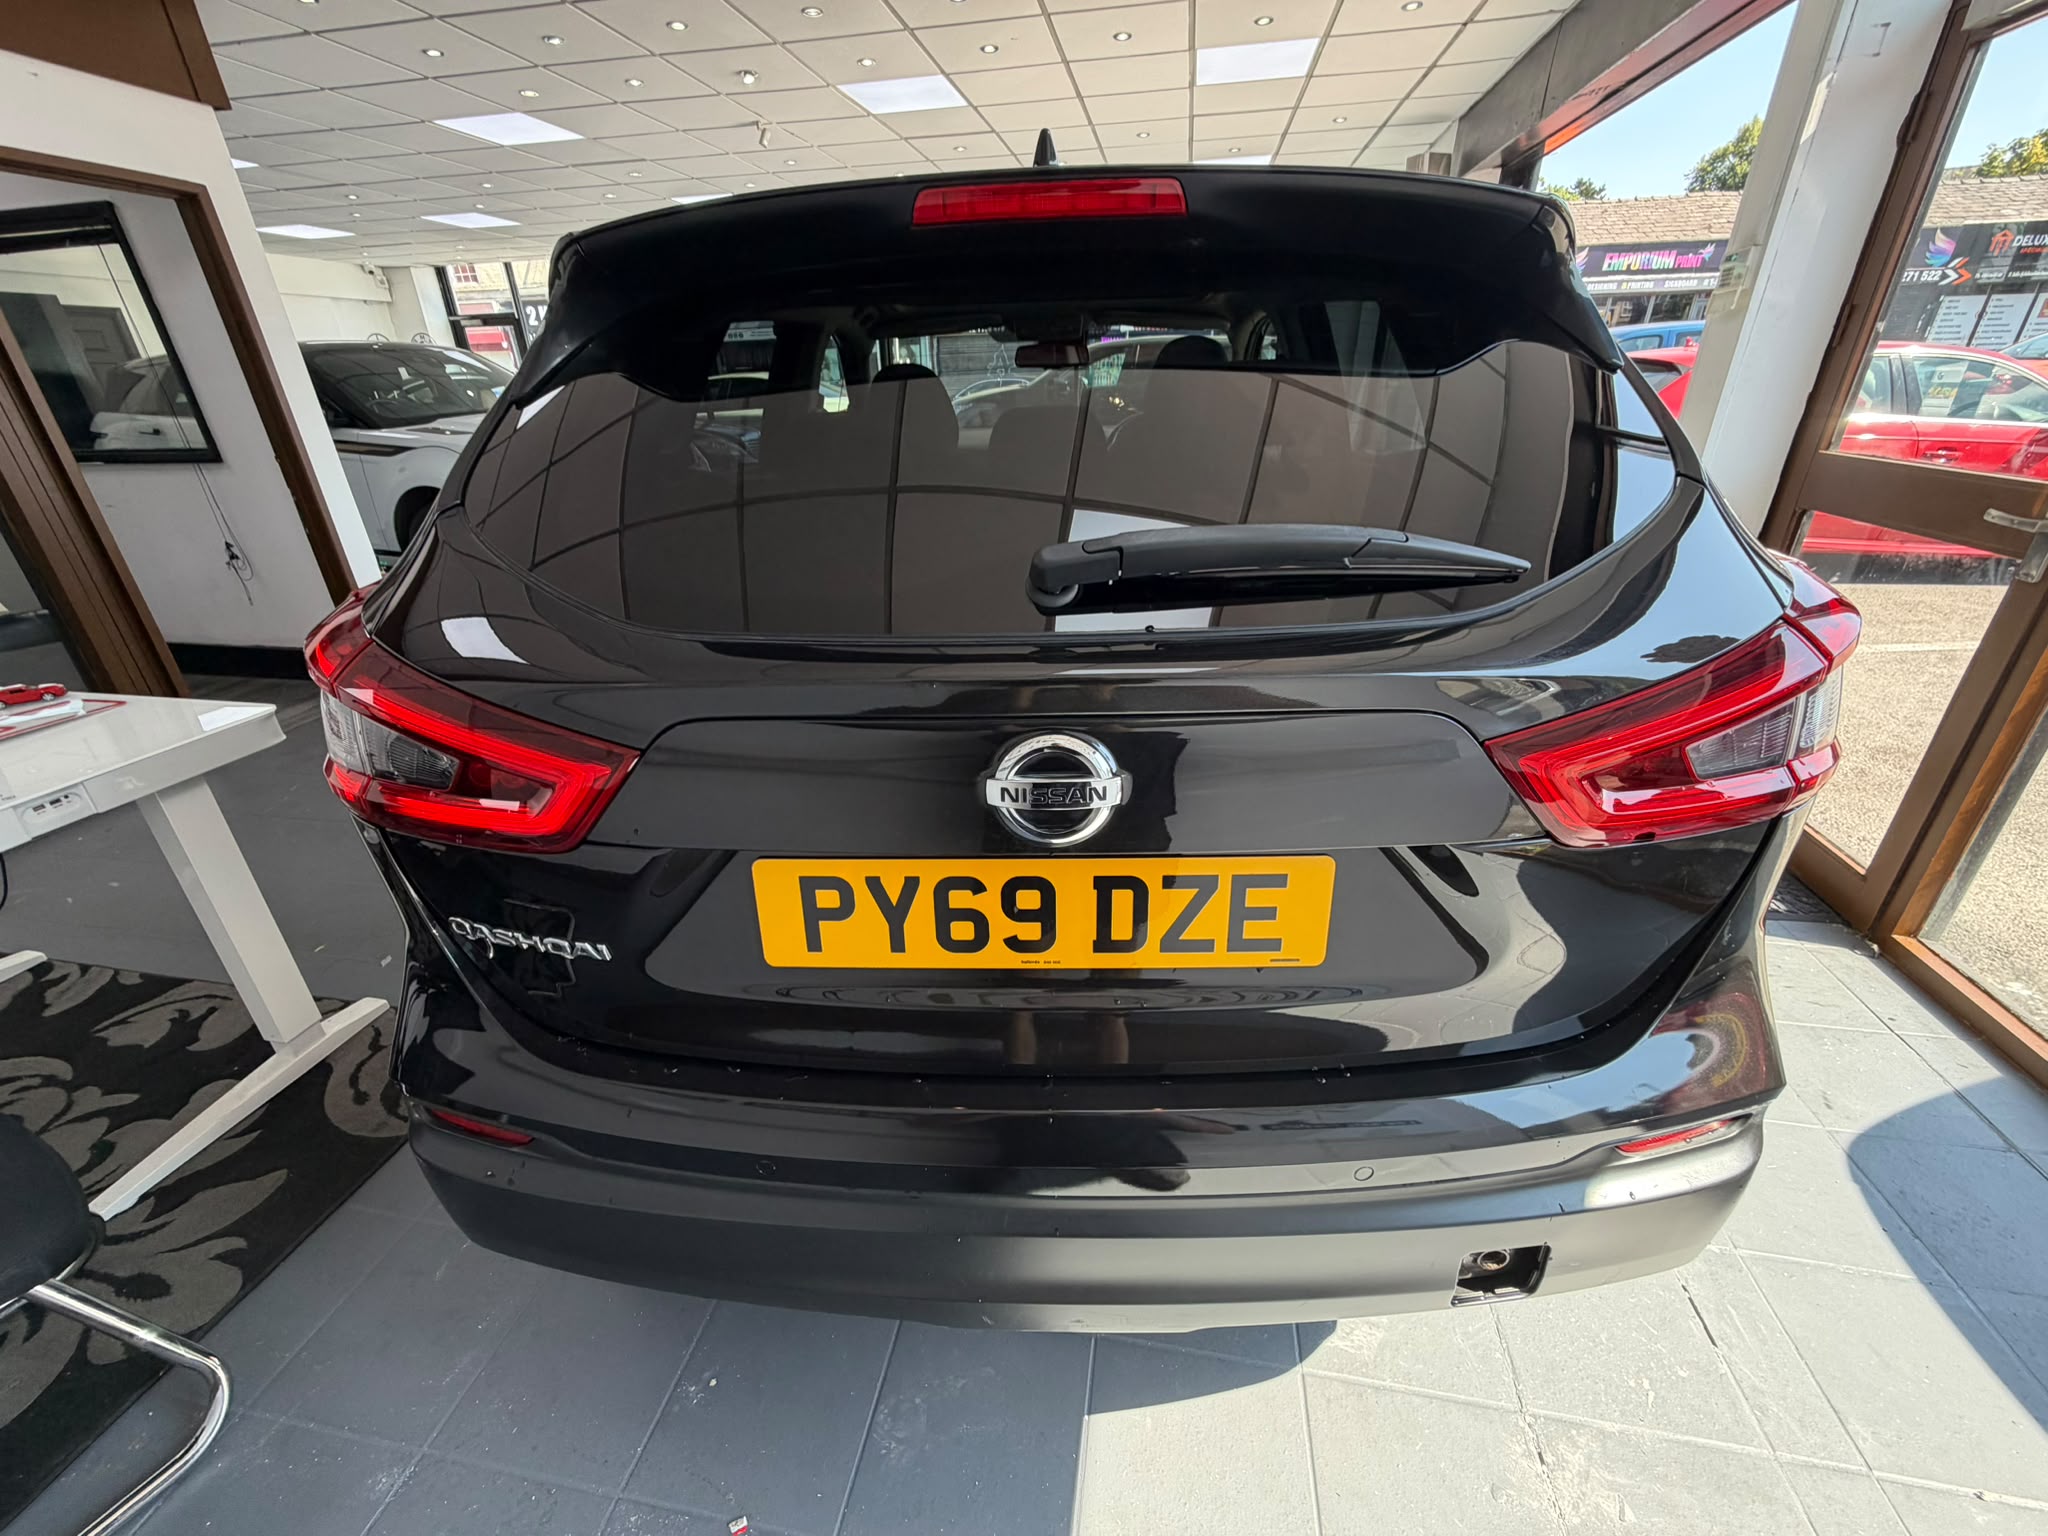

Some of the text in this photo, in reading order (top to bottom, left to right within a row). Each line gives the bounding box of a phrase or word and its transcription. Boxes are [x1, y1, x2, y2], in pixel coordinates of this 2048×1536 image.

[1602, 250, 1704, 271] EMPORIUM PRINT
[1920, 270, 1943, 281] 522
[1000, 786, 1107, 805] NISSAN
[798, 872, 1290, 955] PY69 DZE
[448, 916, 612, 960] QASHQAI
